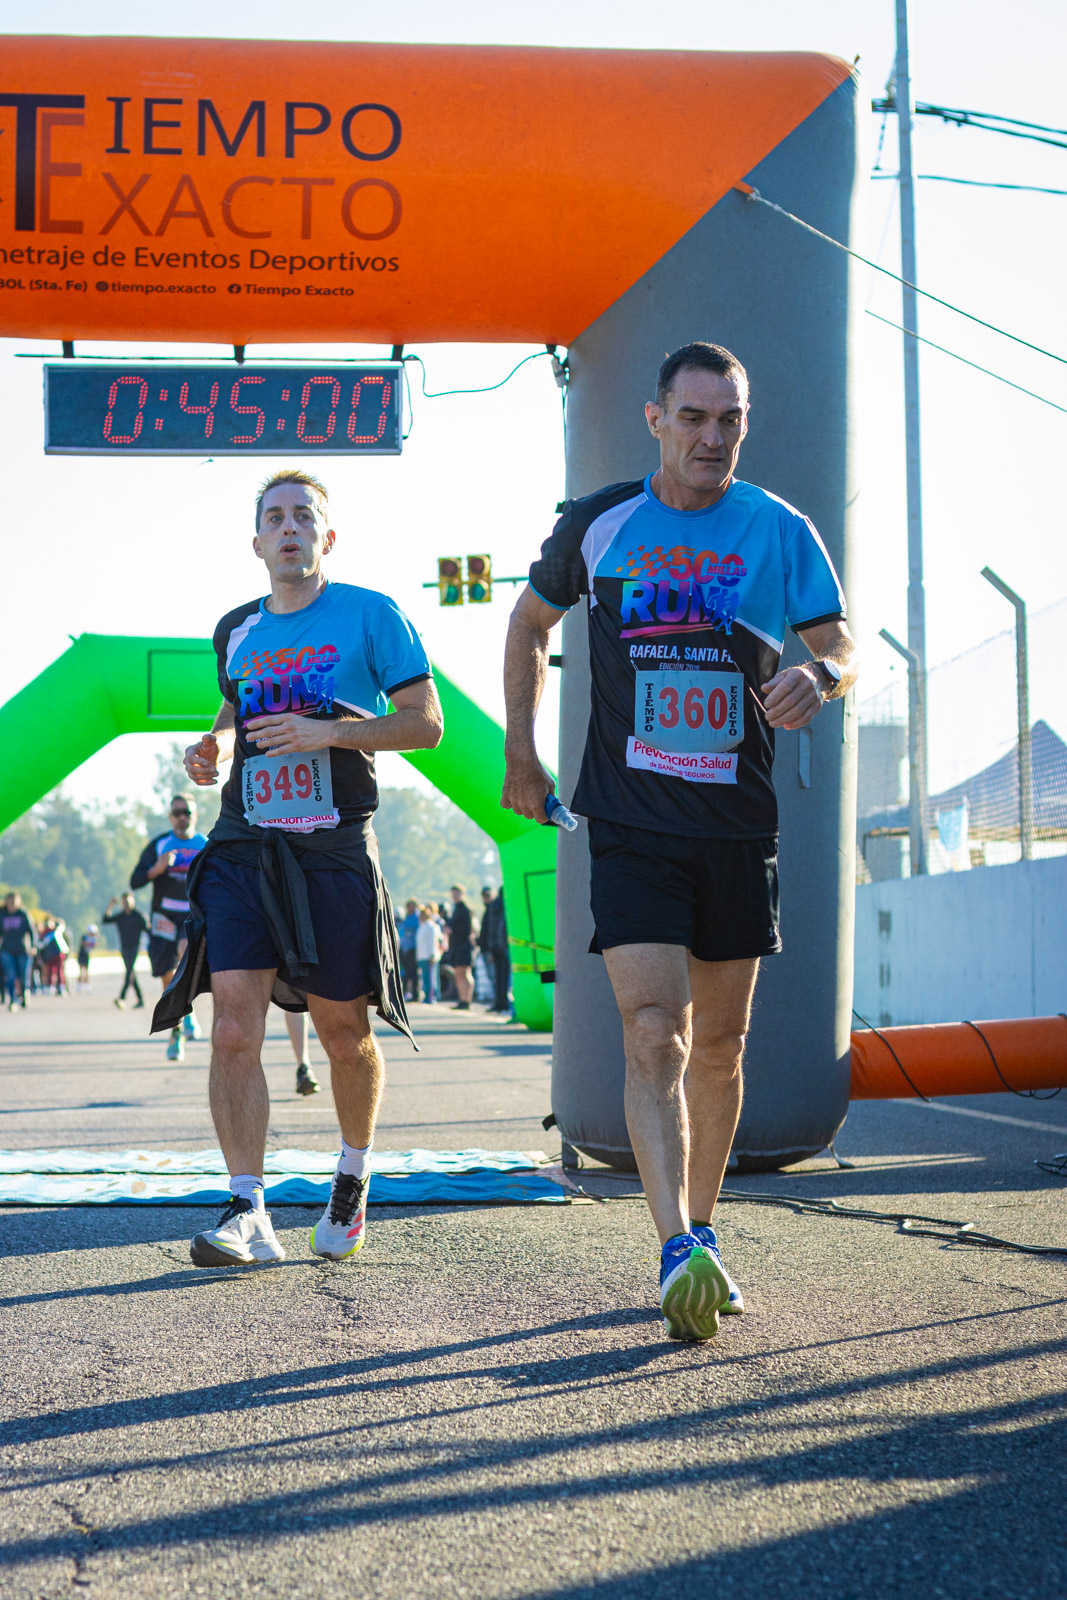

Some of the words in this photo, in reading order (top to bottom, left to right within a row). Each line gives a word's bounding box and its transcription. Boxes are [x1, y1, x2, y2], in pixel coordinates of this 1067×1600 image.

[92, 245, 126, 267] de
[134, 247, 241, 270] Eventos
[249, 249, 400, 275] Deportivos
[29, 279, 62, 291] (Sta.
[66, 280, 88, 292] Fe)
[111, 281, 217, 296] tiempo.exacto
[244, 283, 301, 297] Tiempo
[304, 285, 355, 297] Exacto
[103, 376, 392, 444] 0:45:00
[707, 563, 749, 577] MILLAS
[306, 654, 341, 665] MILLAS
[629, 644, 681, 660] RAFAELA,
[684, 647, 719, 662] SANTA
[644, 682, 655, 733] TIEMPO
[658, 686, 728, 730] 360
[728, 686, 739, 737] EXACTO
[311, 759, 323, 802] EXACTO
[684, 771, 716, 779] SEGUROS
[699, 756, 732, 770] Salud
[246, 771, 255, 812] TIEMPO
[254, 763, 313, 804] 349
